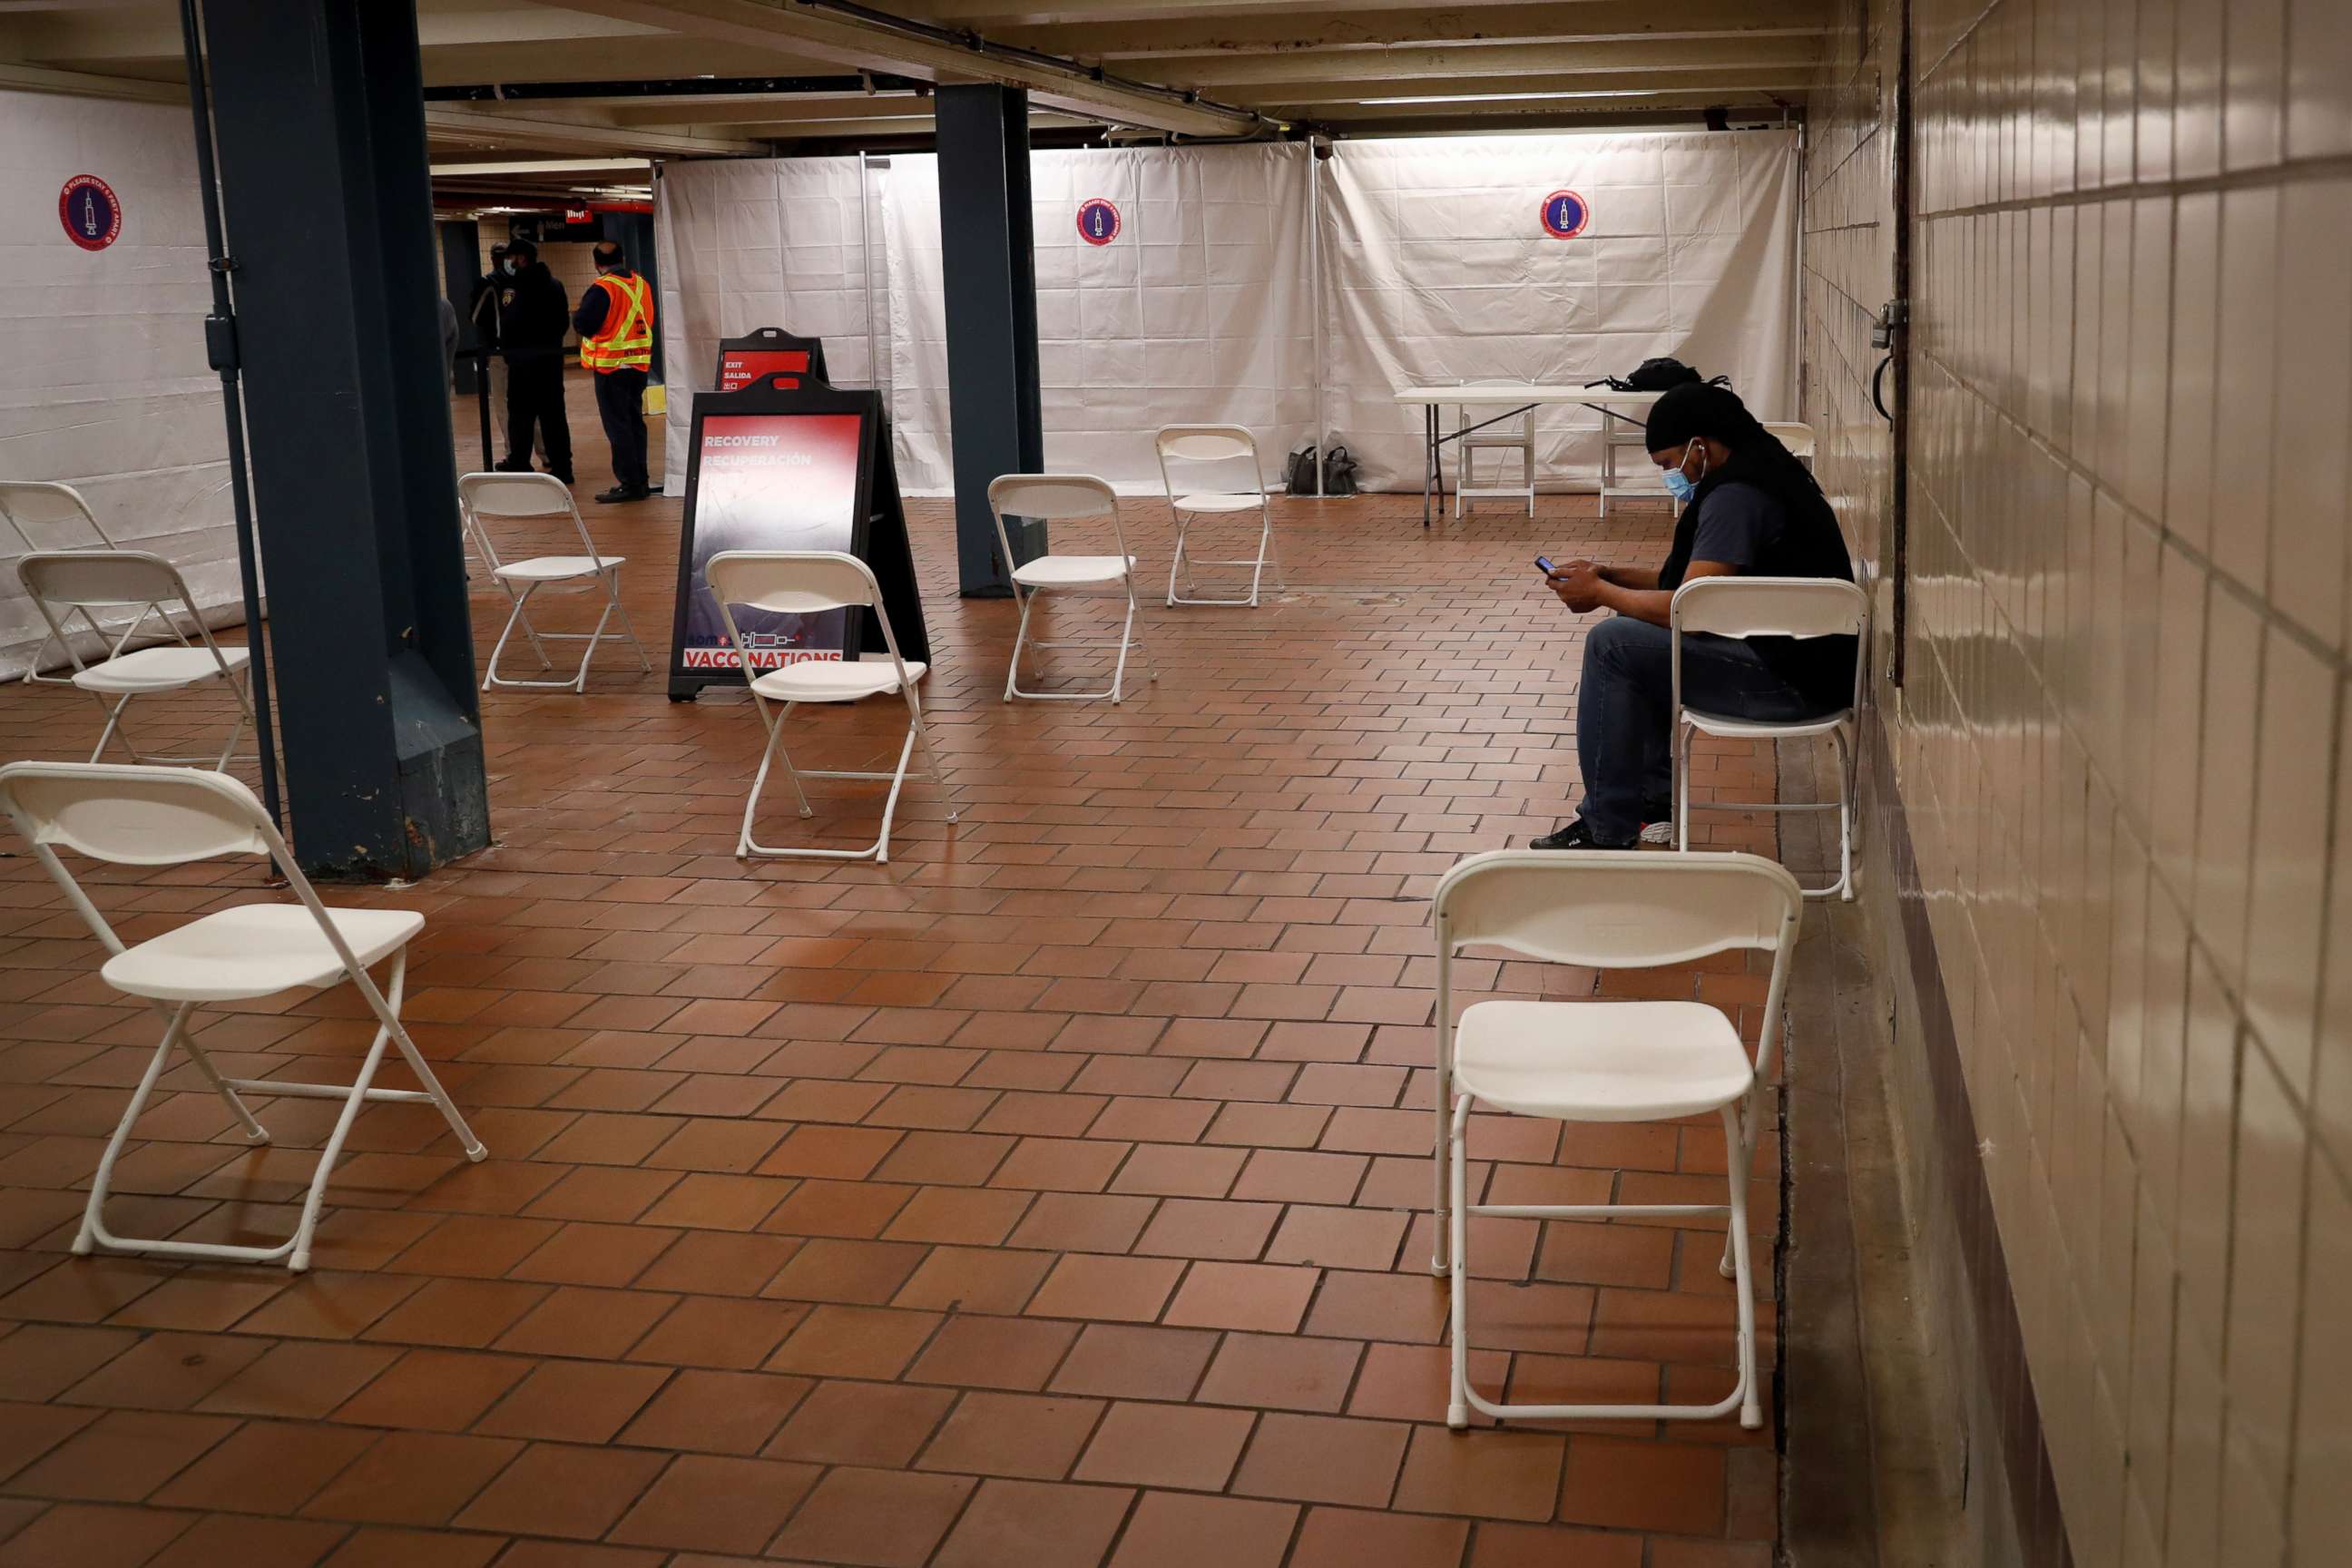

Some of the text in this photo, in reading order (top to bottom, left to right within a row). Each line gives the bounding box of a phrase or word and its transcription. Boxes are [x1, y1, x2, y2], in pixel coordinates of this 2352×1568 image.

[68, 177, 91, 190] PLEASE
[91, 178, 106, 190] STAY
[545, 220, 564, 230] Men
[704, 436, 780, 447] RECOVERY
[702, 453, 813, 466] RECUPERACIÓN
[685, 652, 842, 669] VACCNATIONS
